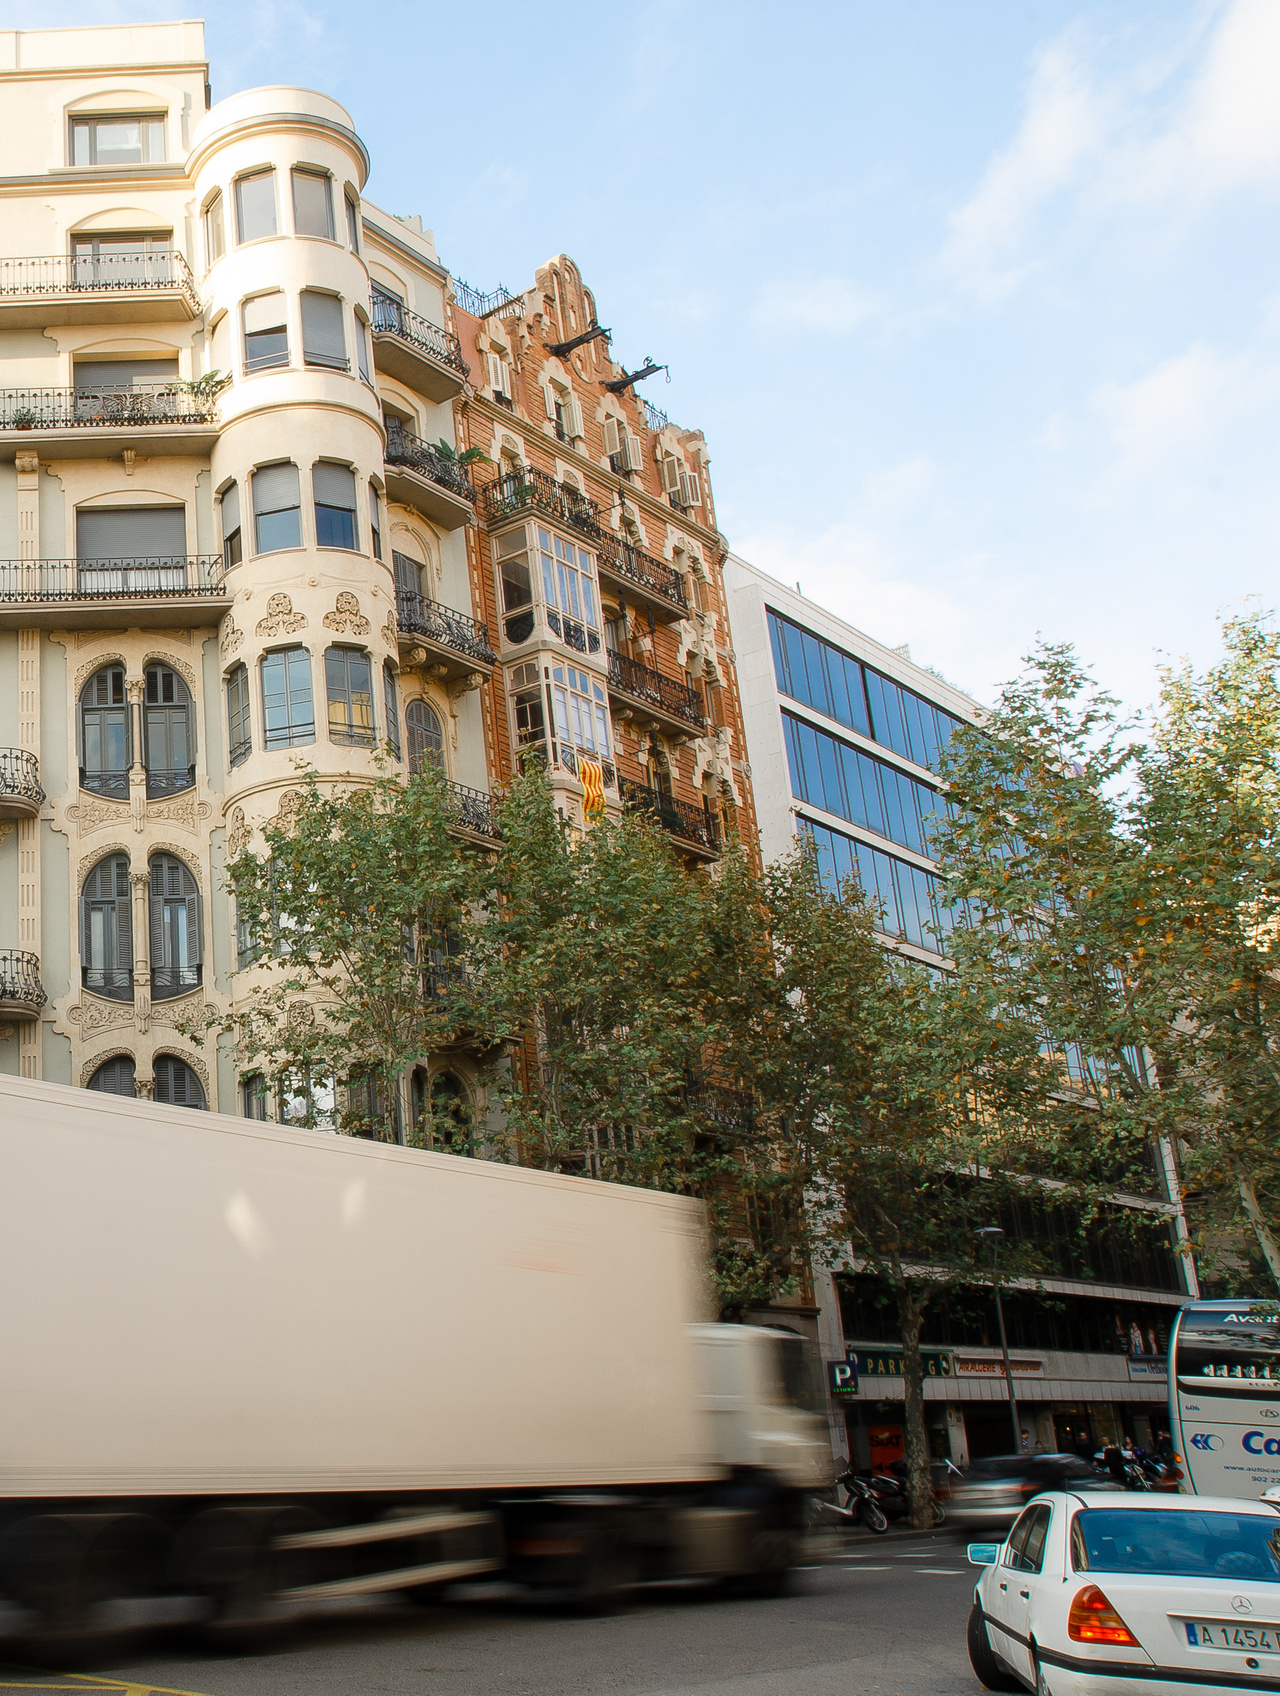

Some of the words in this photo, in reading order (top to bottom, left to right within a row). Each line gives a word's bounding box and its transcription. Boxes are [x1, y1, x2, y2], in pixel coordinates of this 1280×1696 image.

[834, 1364, 851, 1386] P
[867, 1359, 936, 1375] PARKG
[1241, 1430, 1280, 1456] Ca
[1251, 1475, 1268, 1483] 902
[1202, 1626, 1214, 1645] A
[1221, 1627, 1272, 1649] 1454
